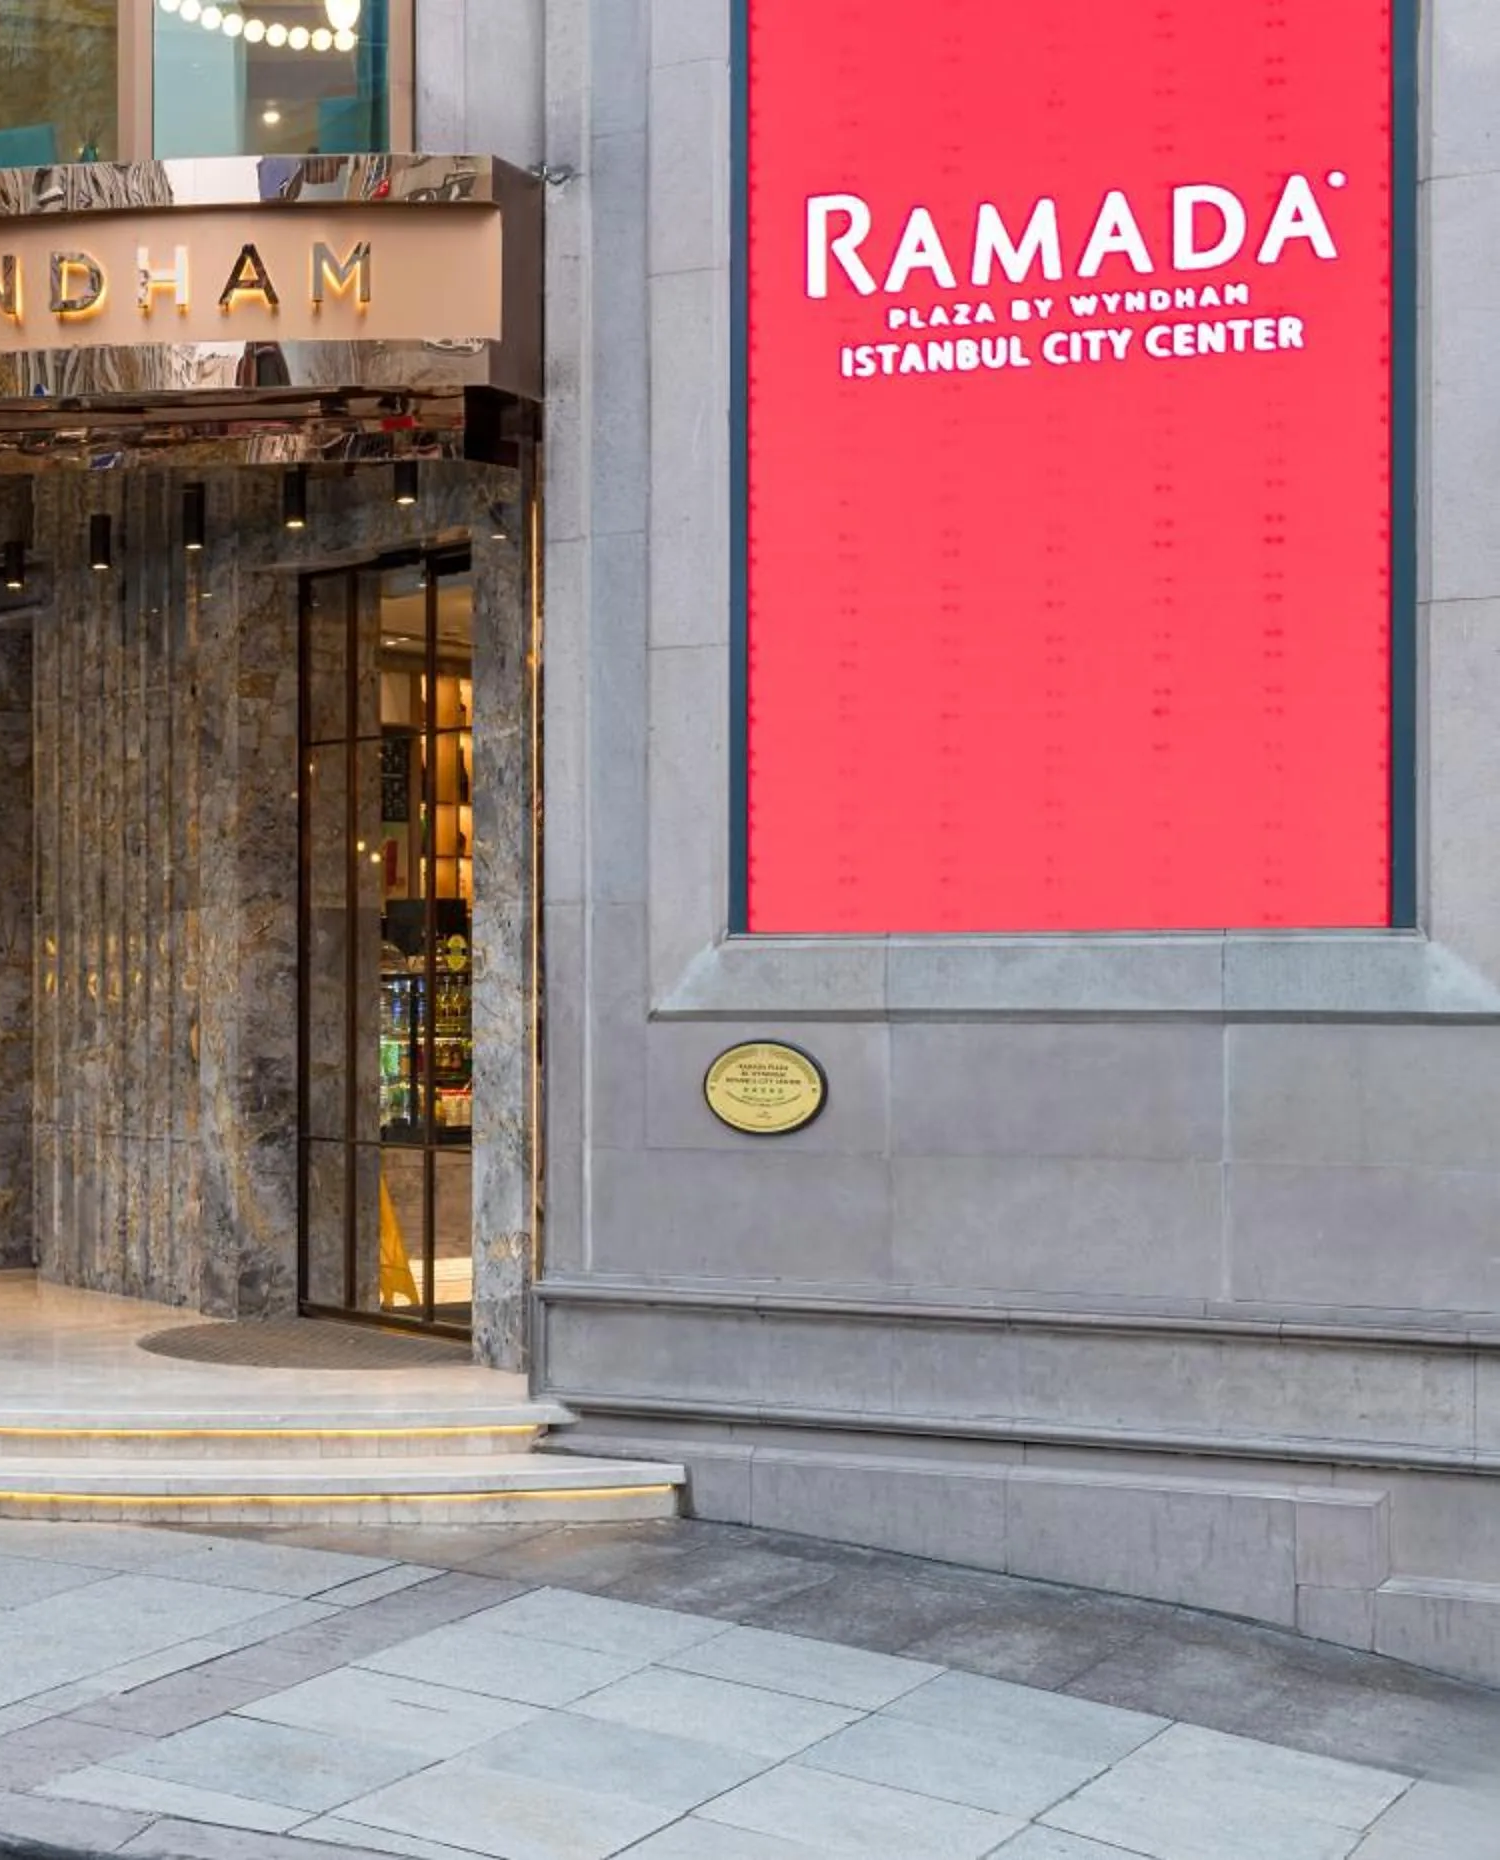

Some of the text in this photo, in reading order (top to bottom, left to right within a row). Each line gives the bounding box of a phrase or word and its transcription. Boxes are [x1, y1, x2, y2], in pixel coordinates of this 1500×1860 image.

[807, 174, 1338, 299] RAMADA
[888, 283, 1249, 330] PLAZA BY WYNDHAM
[842, 316, 1304, 377] ISTANBUL CITY CENTER
